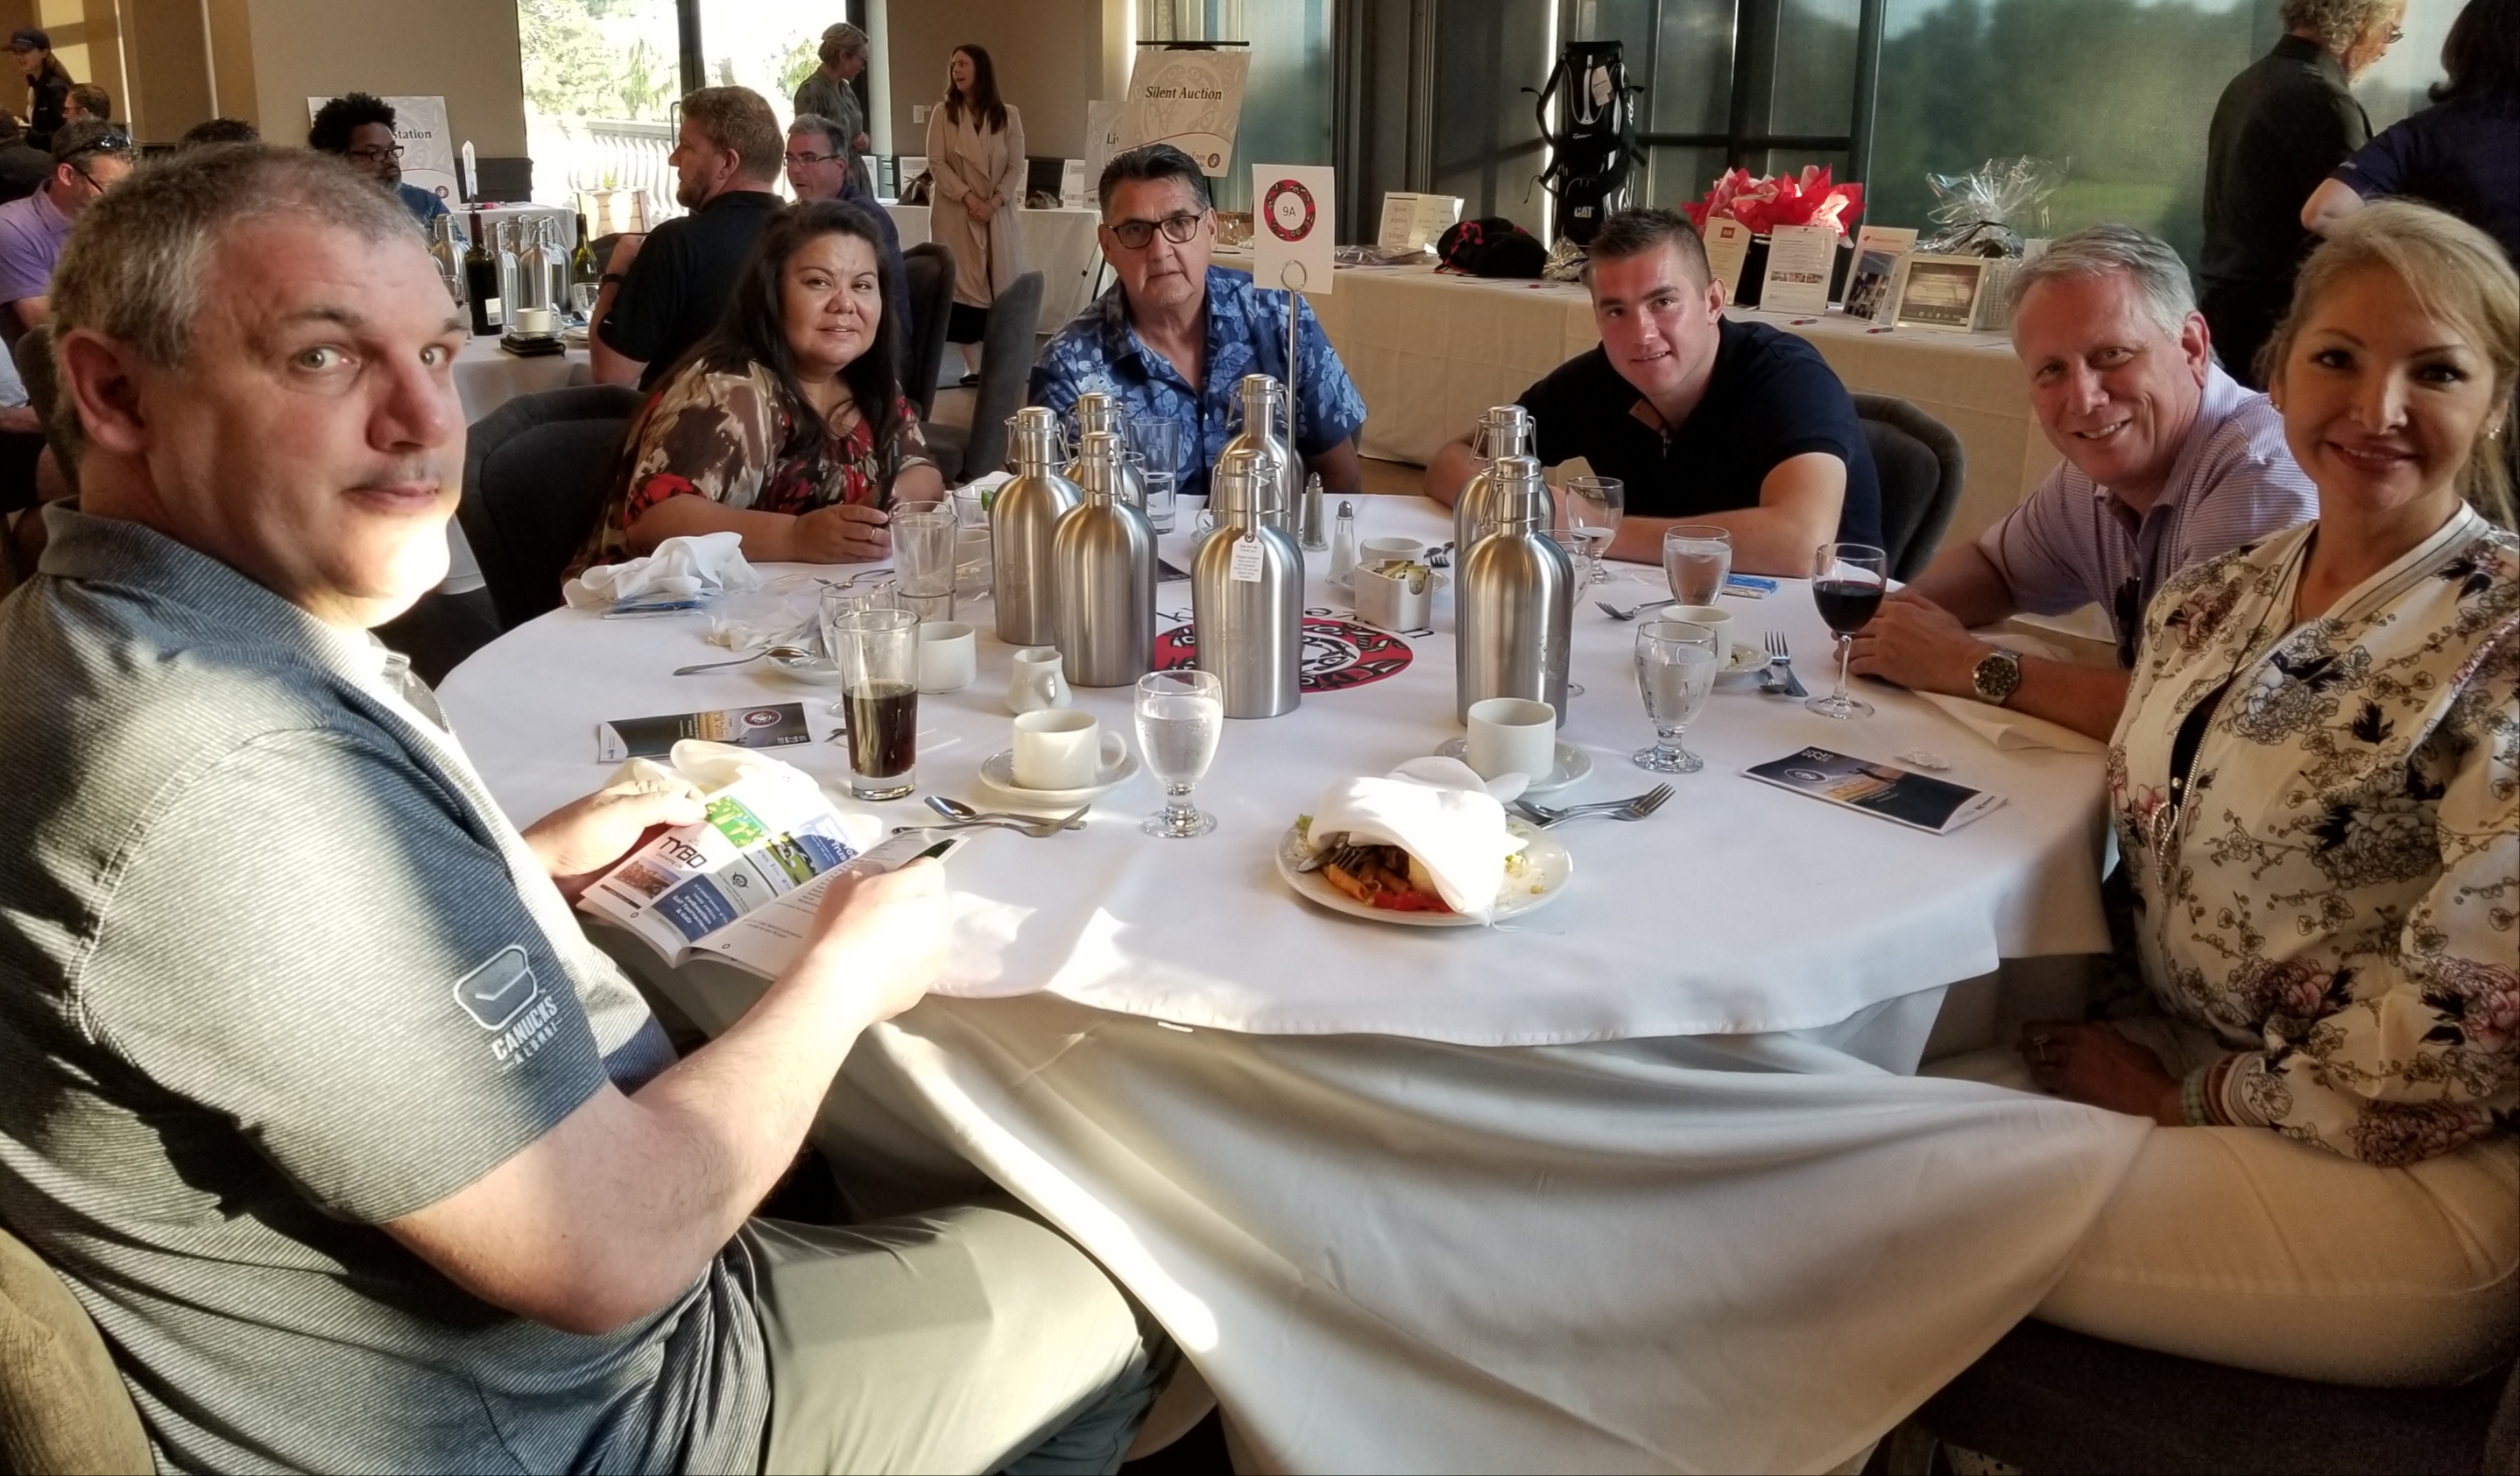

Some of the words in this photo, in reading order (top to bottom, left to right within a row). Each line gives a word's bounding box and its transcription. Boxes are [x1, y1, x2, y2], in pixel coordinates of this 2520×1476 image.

[1145, 86, 1177, 98] Silent
[1178, 88, 1222, 100] Auction
[1282, 206, 1296, 217] 9A
[1574, 206, 1595, 218] CAT
[785, 736, 799, 745] 22
[659, 837, 708, 869] TYBO
[672, 895, 684, 905] Golf
[682, 903, 709, 935] Tournament
[491, 996, 558, 1061] CANUCKS
